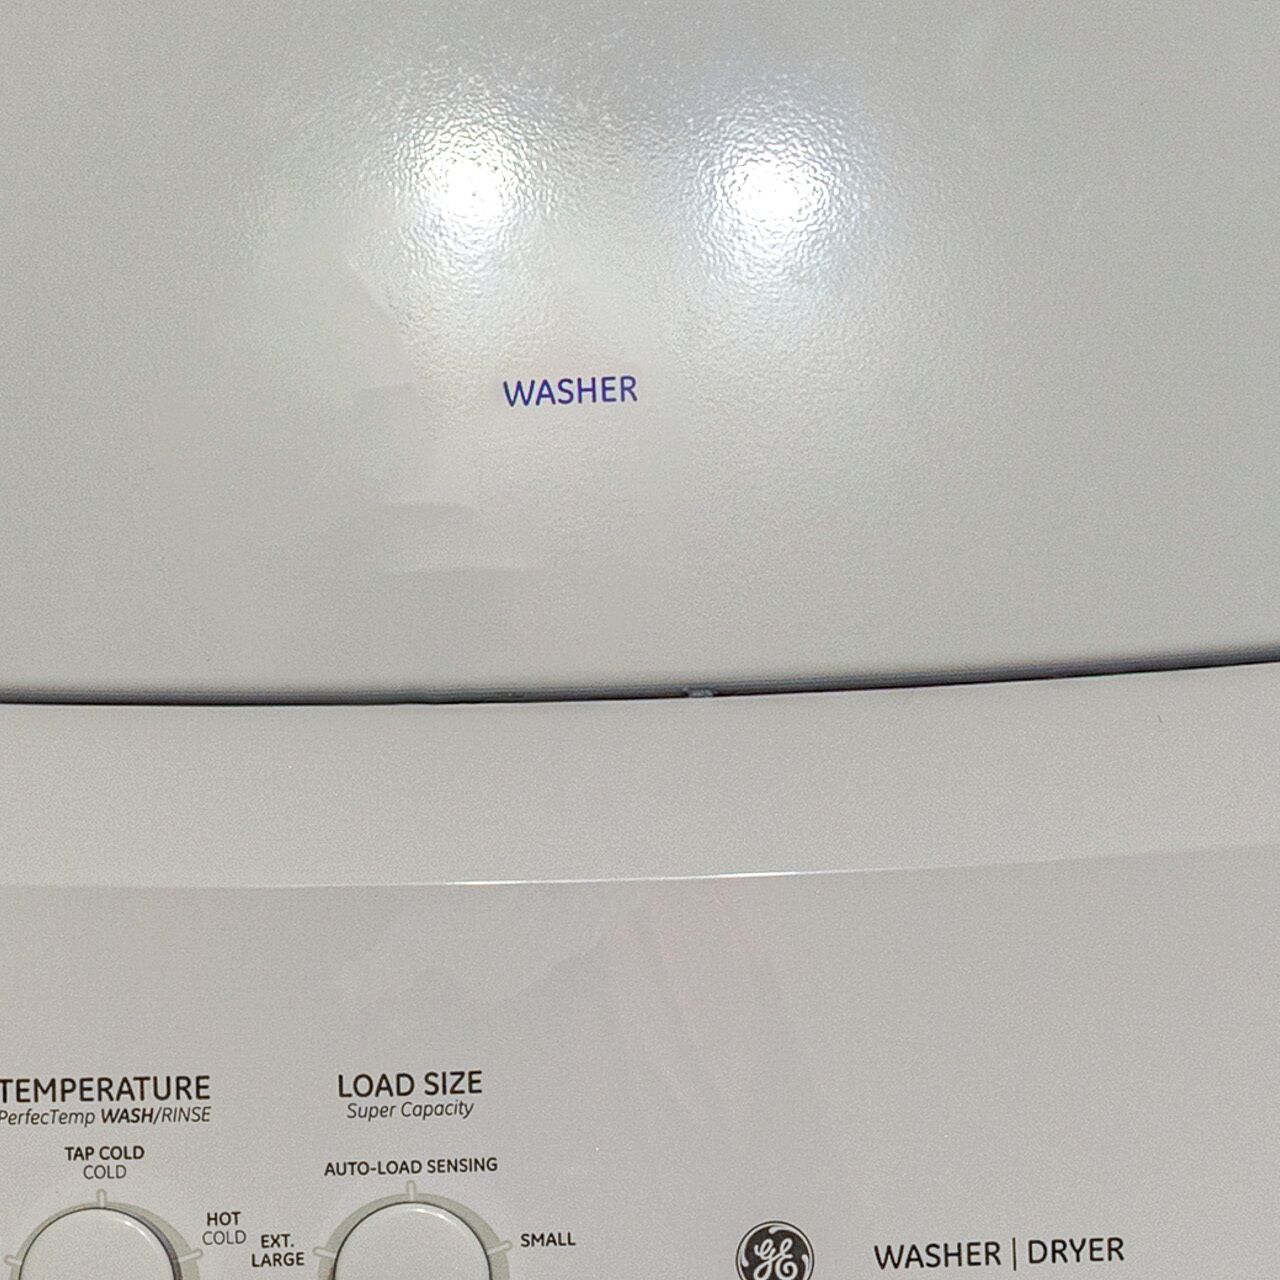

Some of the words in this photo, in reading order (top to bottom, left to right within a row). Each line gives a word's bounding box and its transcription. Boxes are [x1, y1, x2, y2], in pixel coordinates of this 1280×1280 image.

[503, 376, 637, 407] WASHER
[338, 1073, 415, 1097] LOAD
[424, 1070, 482, 1096] SIZE
[347, 1103, 396, 1122] Super
[401, 1101, 474, 1120] Capacity
[65, 1146, 95, 1160] TAP
[99, 1145, 145, 1160] COLD
[83, 1164, 127, 1180] COLD
[324, 1160, 422, 1176] AUTO-LOAD
[427, 1157, 498, 1173] SENSING
[207, 1211, 241, 1226] HOT
[202, 1230, 247, 1245] COLD
[261, 1234, 294, 1248] EXT.
[521, 1232, 576, 1247] SMALL
[252, 1252, 304, 1268] LARGE
[874, 1241, 1001, 1269] WASHER
[1028, 1237, 1124, 1264] DRYER
